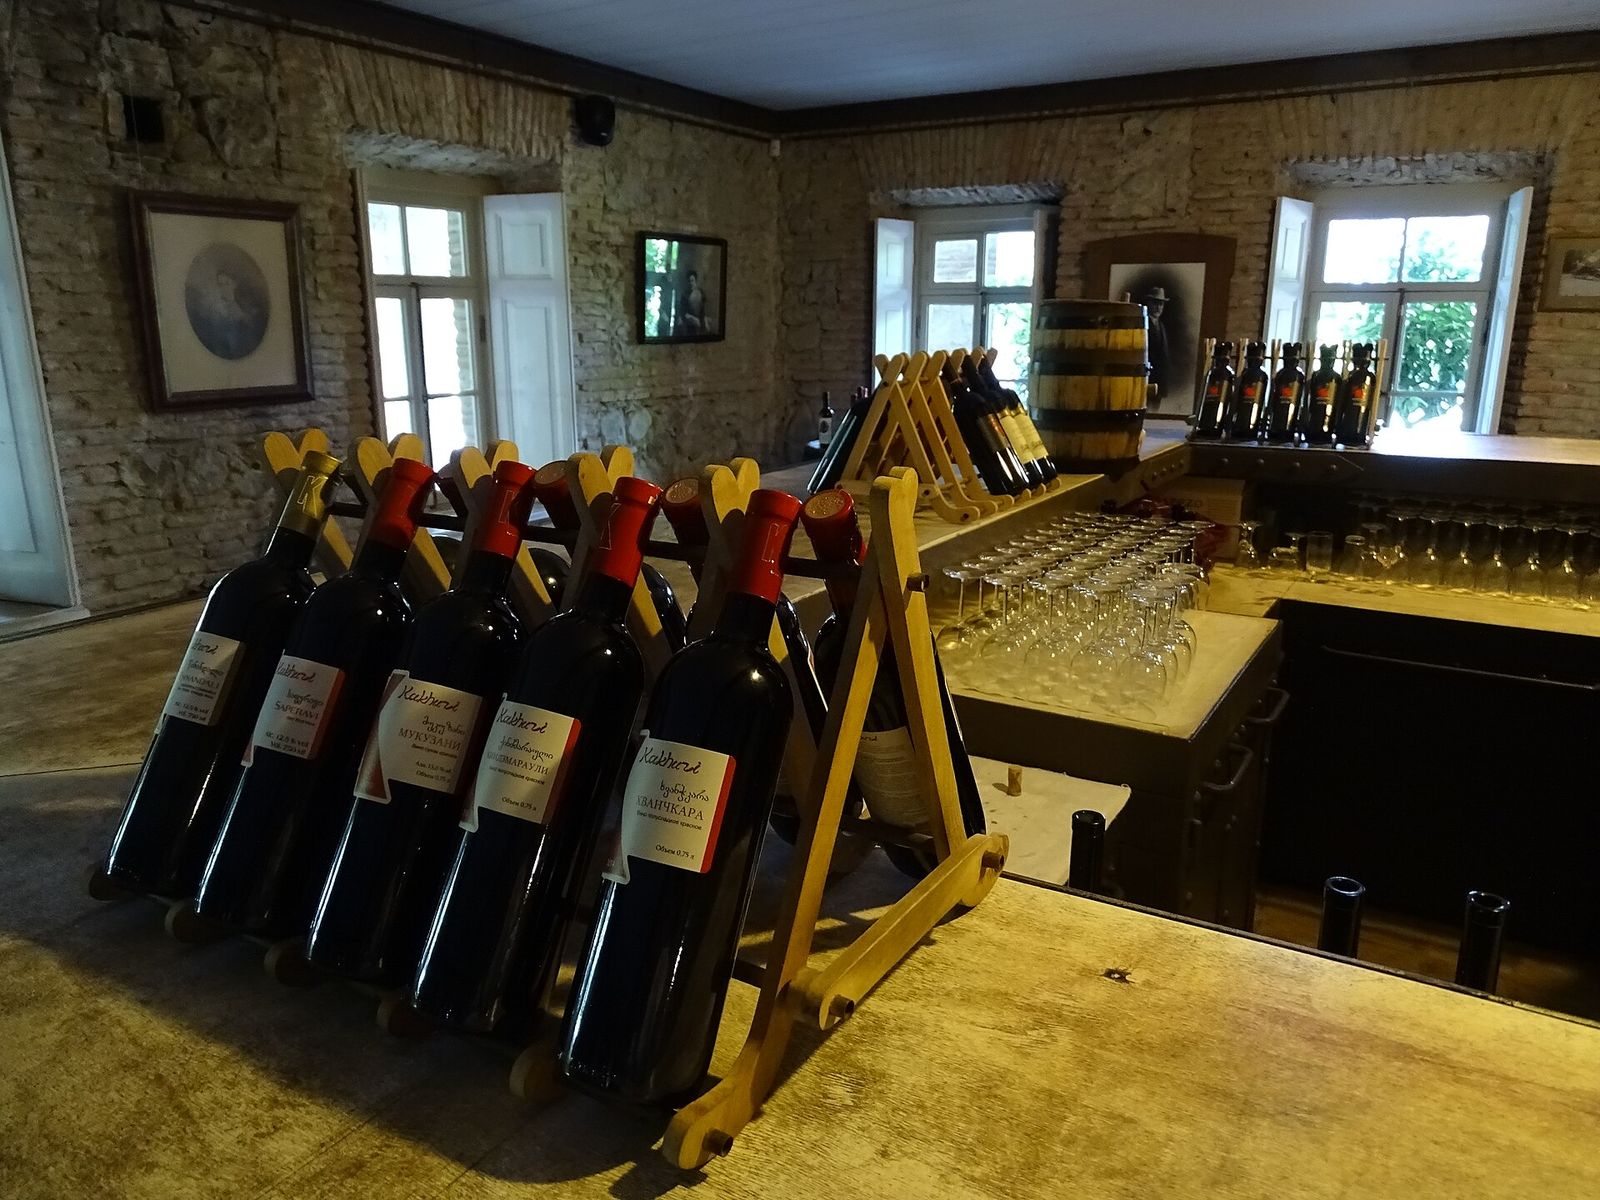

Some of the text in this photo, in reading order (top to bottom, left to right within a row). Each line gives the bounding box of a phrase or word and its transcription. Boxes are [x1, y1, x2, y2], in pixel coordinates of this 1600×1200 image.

[297, 475, 328, 517] K
[399, 728, 461, 750] МУКУЗАНИ
[639, 746, 702, 774] Kakhuri
